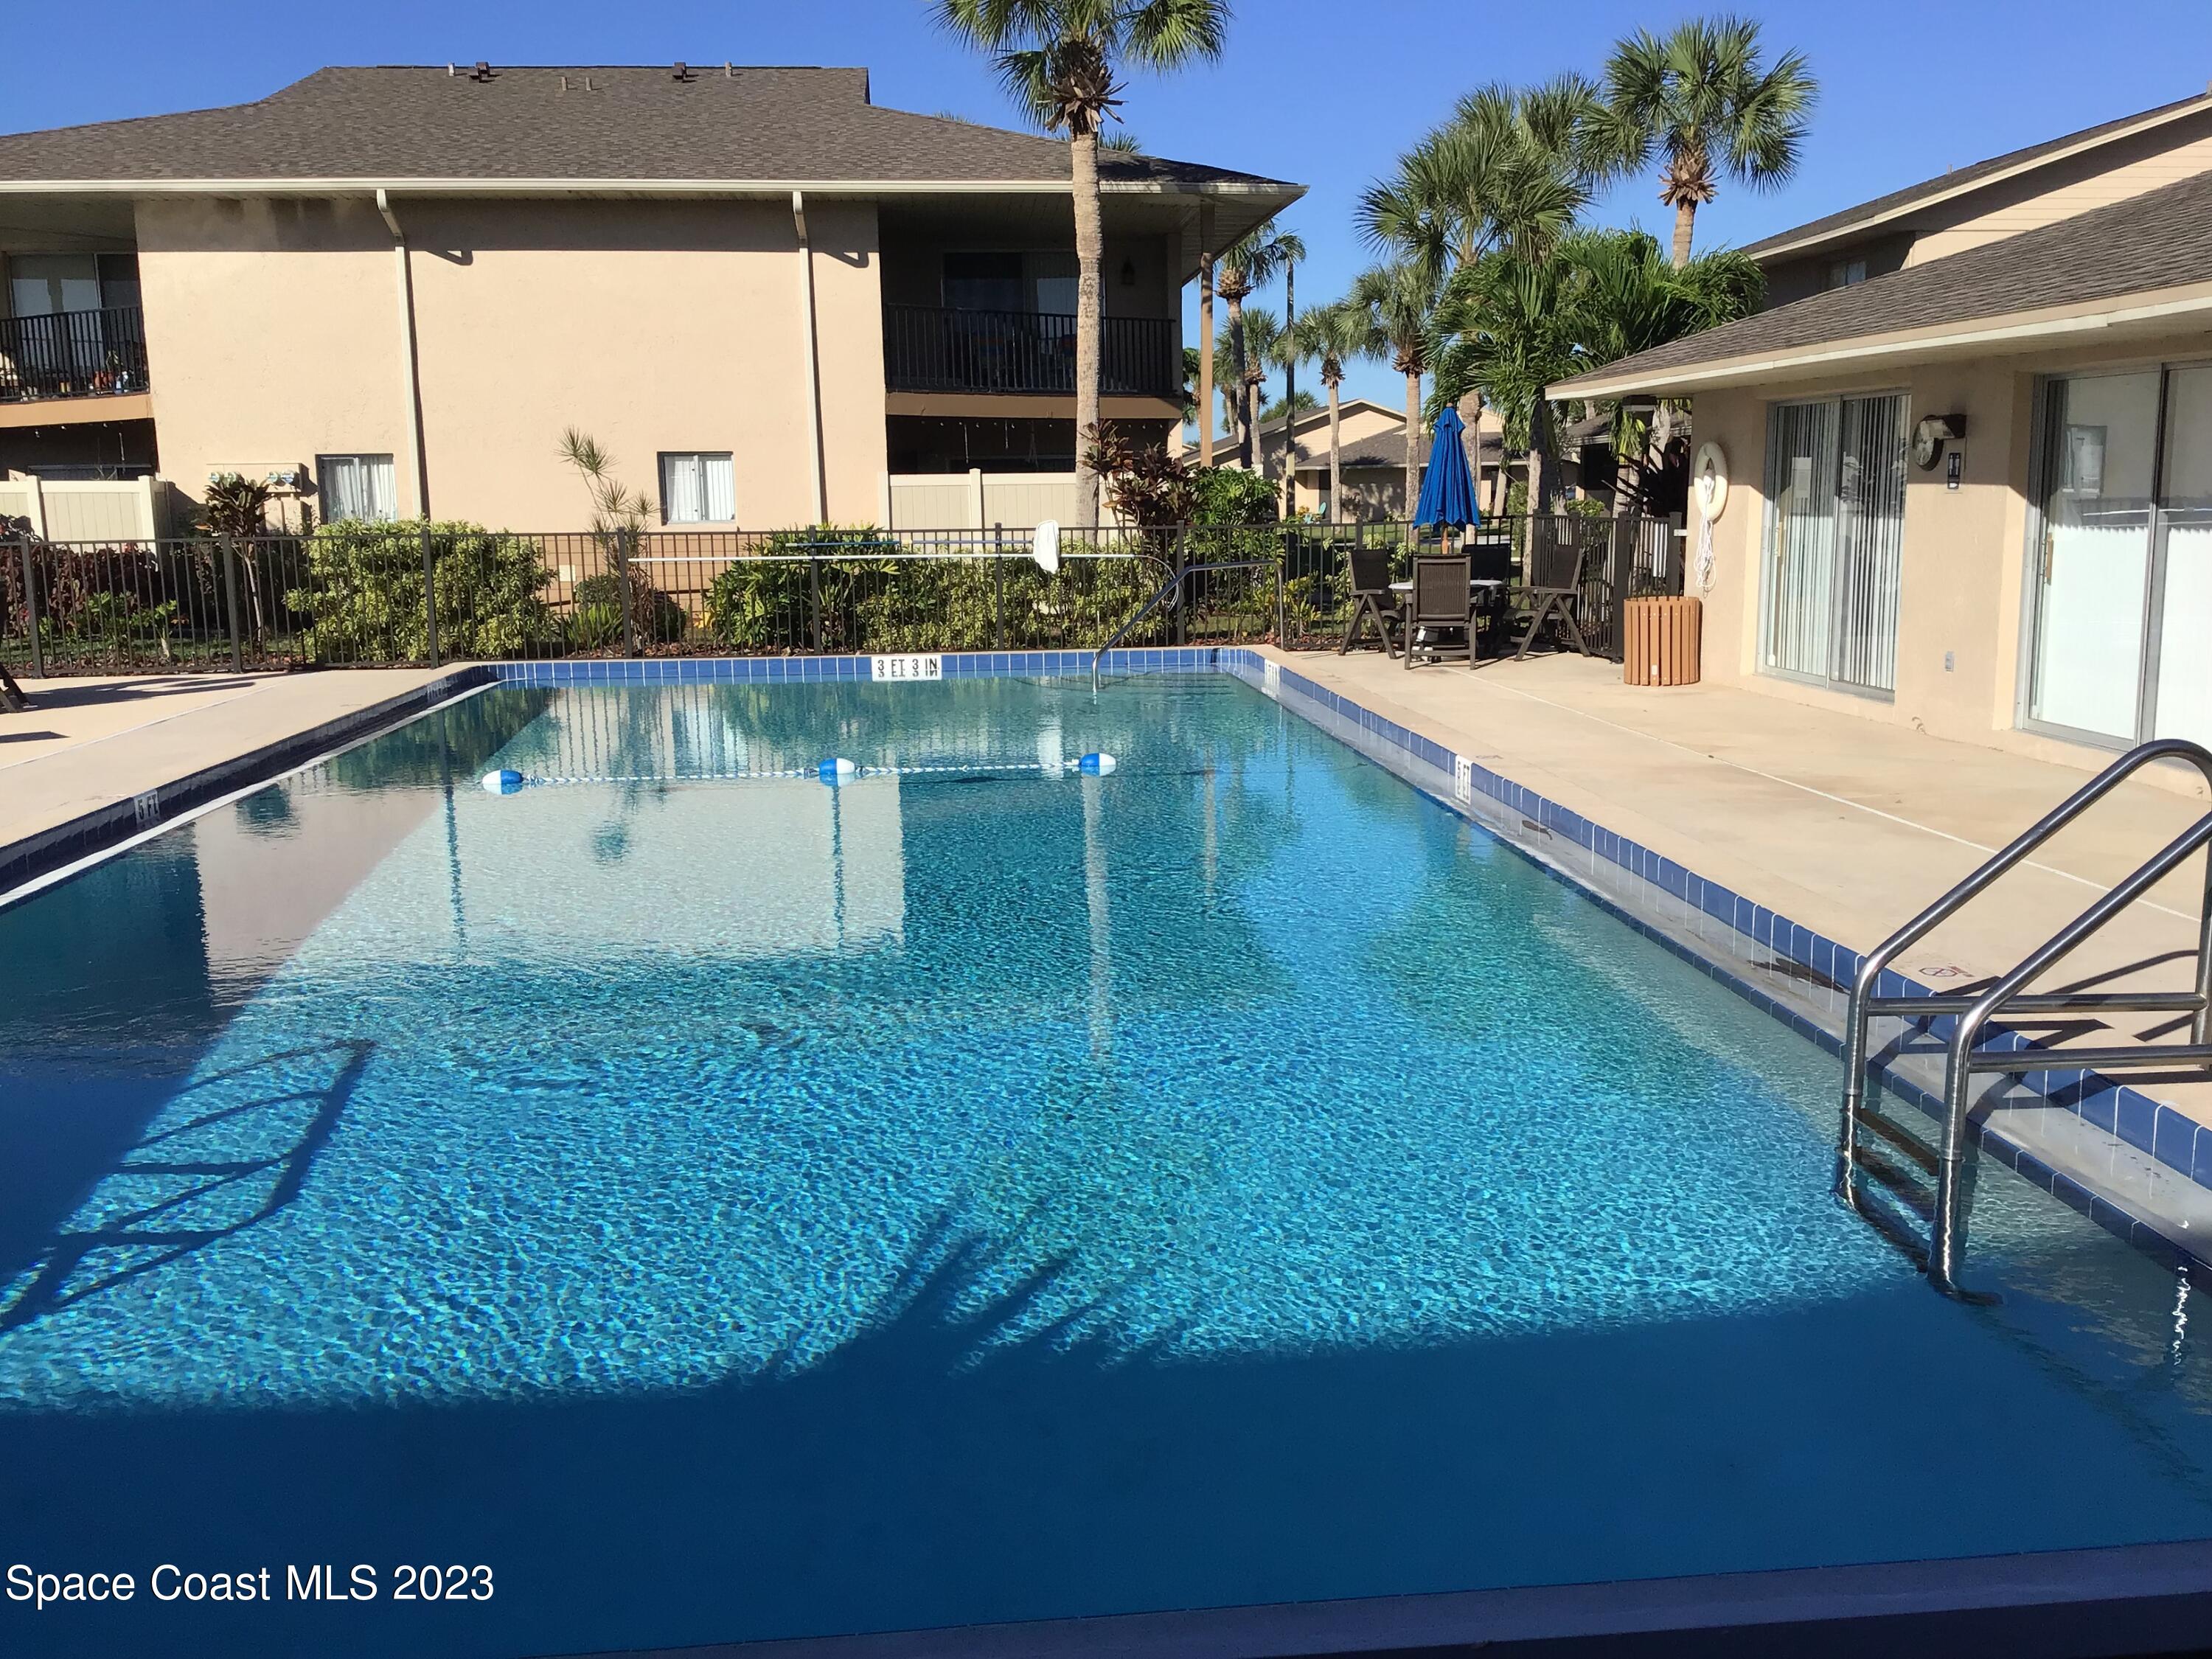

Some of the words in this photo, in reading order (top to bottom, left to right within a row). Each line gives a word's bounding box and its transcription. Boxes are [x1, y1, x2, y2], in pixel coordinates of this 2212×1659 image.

[877, 659, 885, 671] 3
[912, 658, 919, 670] 3
[138, 799, 145, 820] 5
